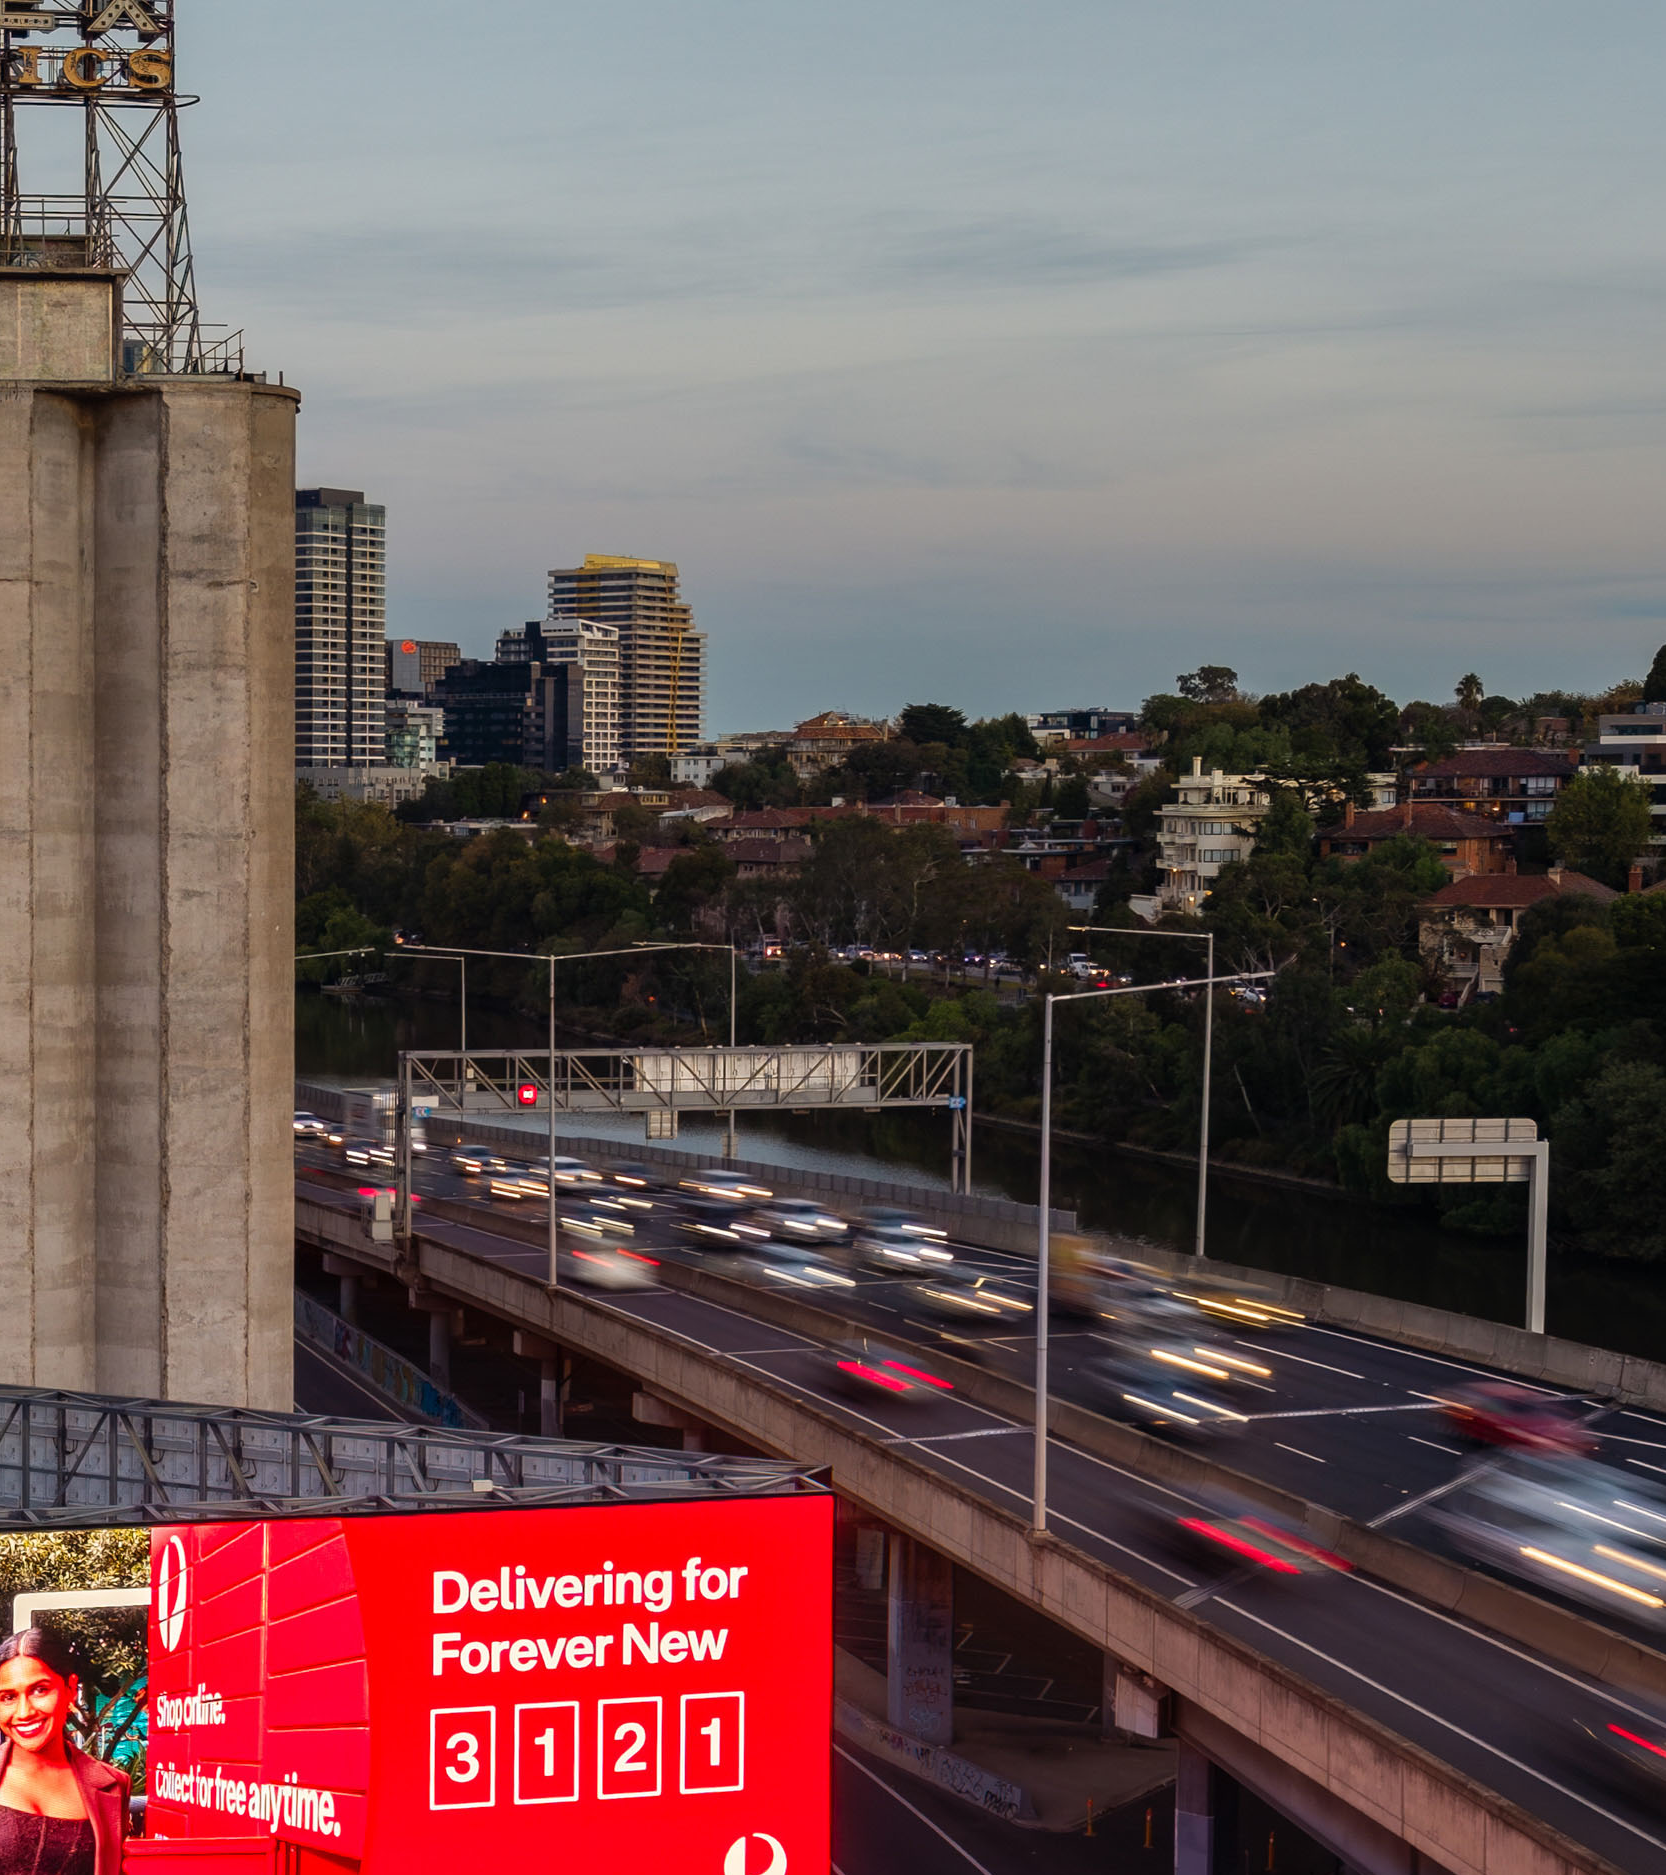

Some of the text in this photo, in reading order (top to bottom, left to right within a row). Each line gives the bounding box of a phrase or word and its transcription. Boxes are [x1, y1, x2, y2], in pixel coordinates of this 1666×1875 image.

[434, 1557, 748, 1613] Delivering for
[433, 1622, 728, 1675] Forever New
[156, 1682, 226, 1732] Shop online.
[155, 1762, 341, 1837] Collect for free anytime.
